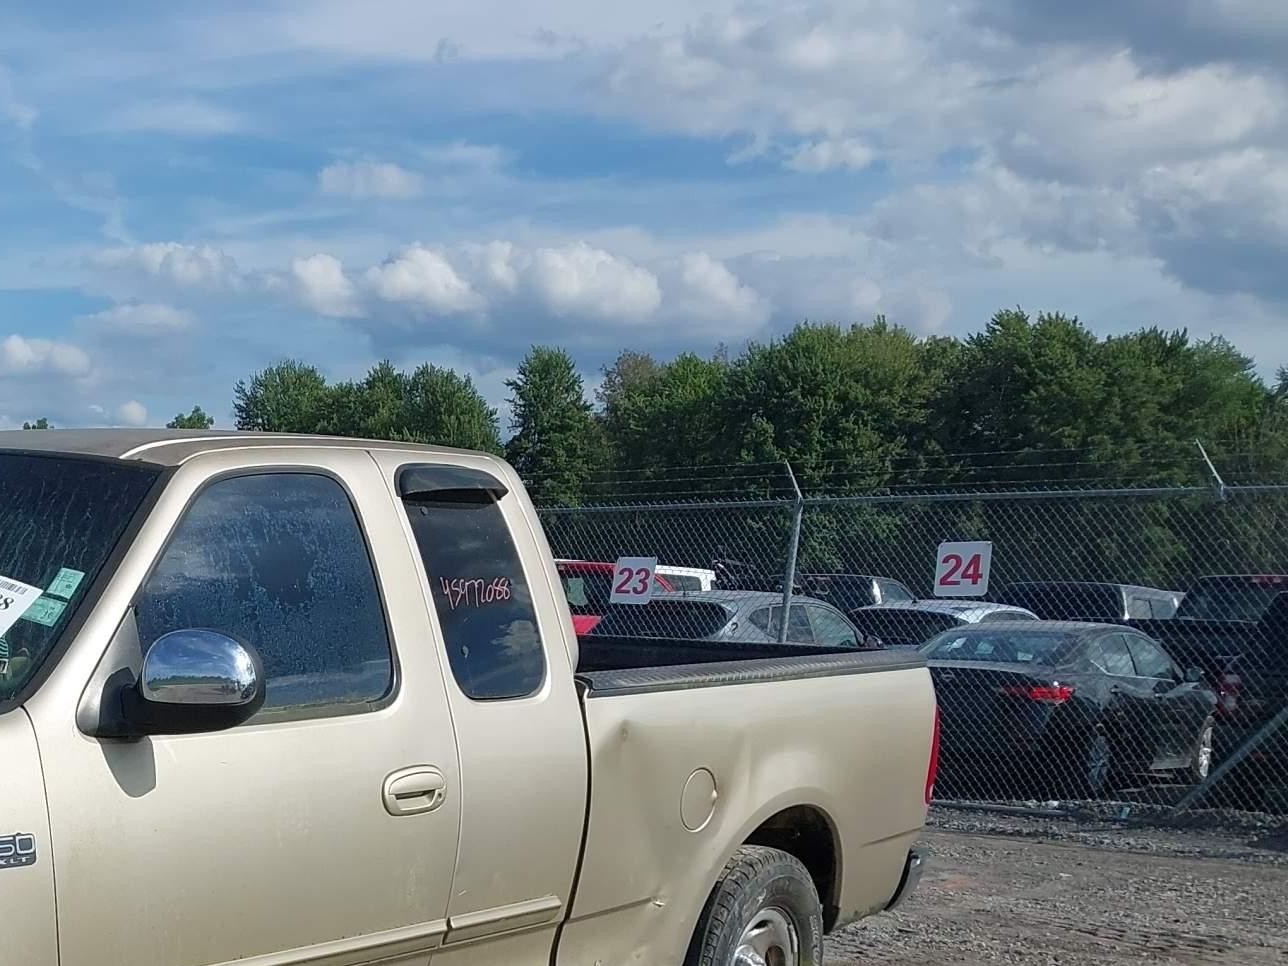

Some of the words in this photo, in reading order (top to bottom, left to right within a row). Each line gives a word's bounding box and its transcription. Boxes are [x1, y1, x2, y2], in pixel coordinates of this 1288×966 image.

[614, 567, 651, 595] 23
[939, 553, 983, 586] 24
[439, 576, 511, 610] 45972088
